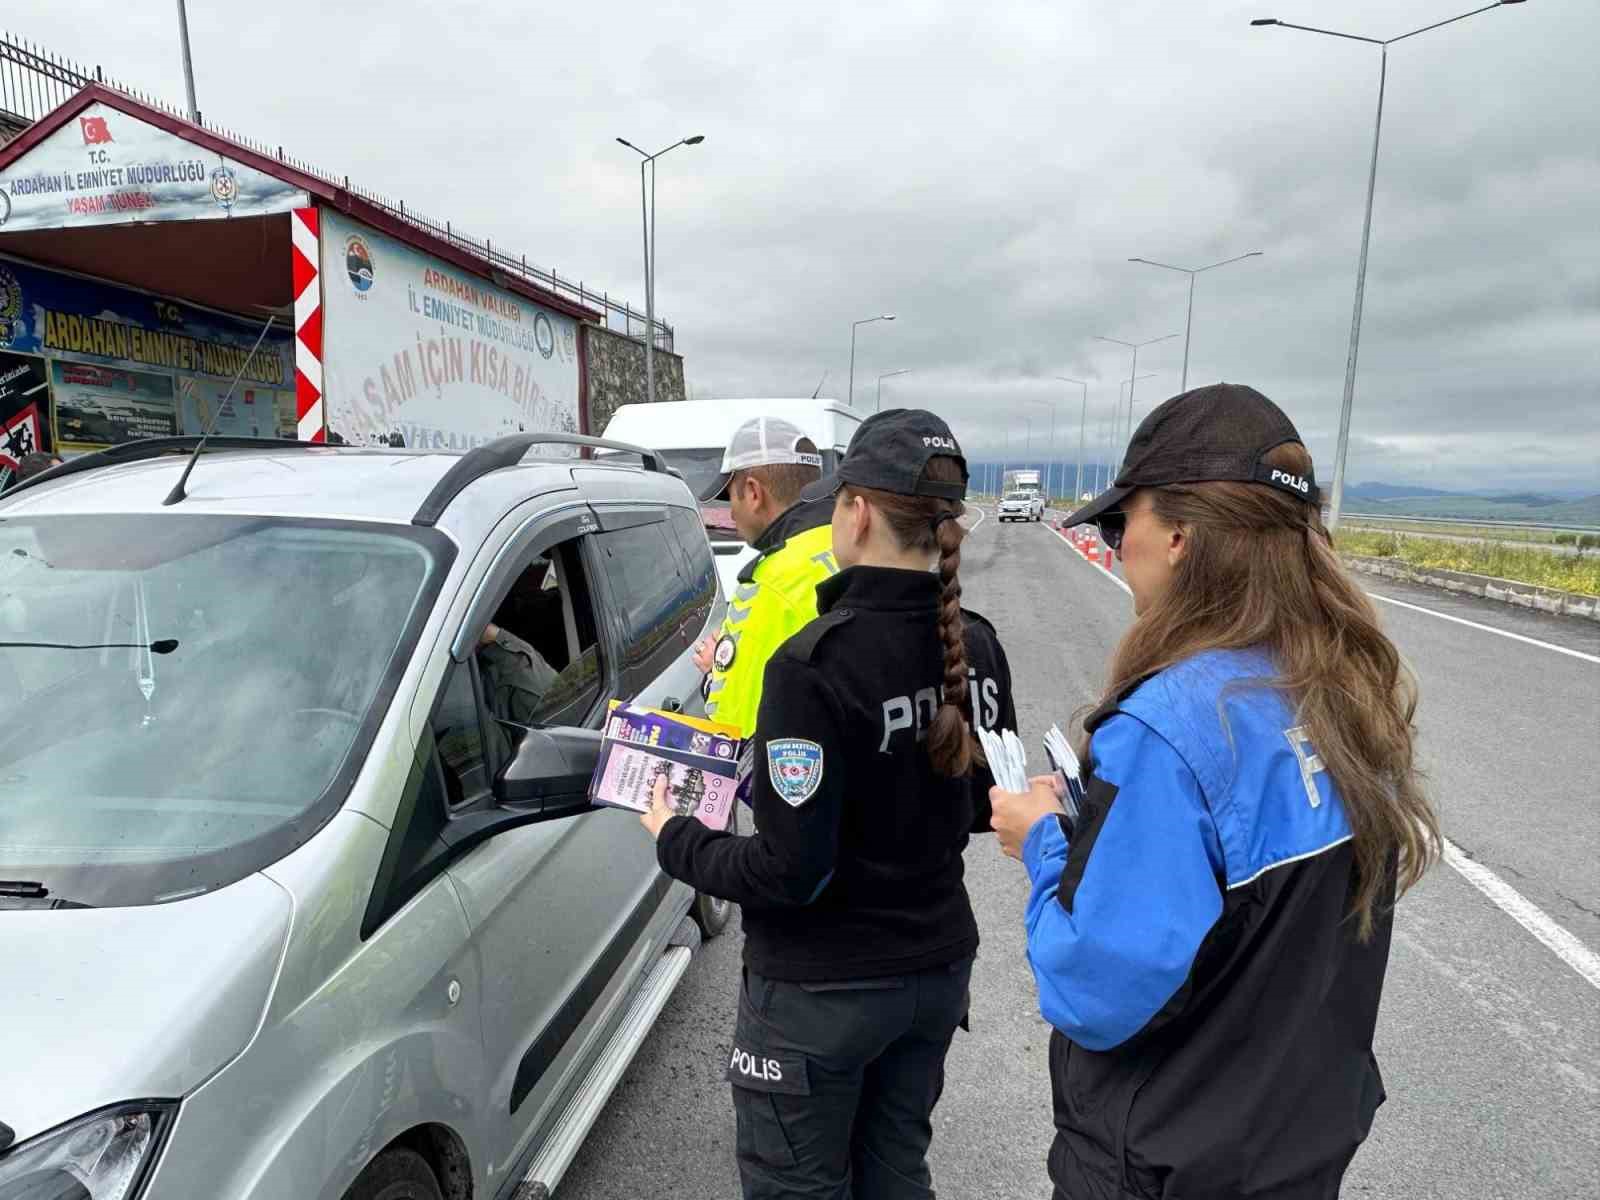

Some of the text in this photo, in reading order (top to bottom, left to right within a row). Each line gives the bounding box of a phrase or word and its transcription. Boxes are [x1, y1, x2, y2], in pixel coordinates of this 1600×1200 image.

[88, 151, 111, 164] T.C.
[10, 160, 205, 197] ARDAHAN İL EMNİYET MÜDÜRLÜĞÜ
[407, 279, 421, 313] İL
[423, 295, 474, 332] EMNİYET
[424, 267, 479, 306] ARDAHAN
[45, 311, 128, 358] ARDAHAN
[416, 328, 464, 399] İÇİN
[470, 338, 511, 397] KISA
[1271, 469, 1309, 493] POLİS
[879, 667, 999, 754] POİS
[729, 1047, 782, 1081] POLİS
